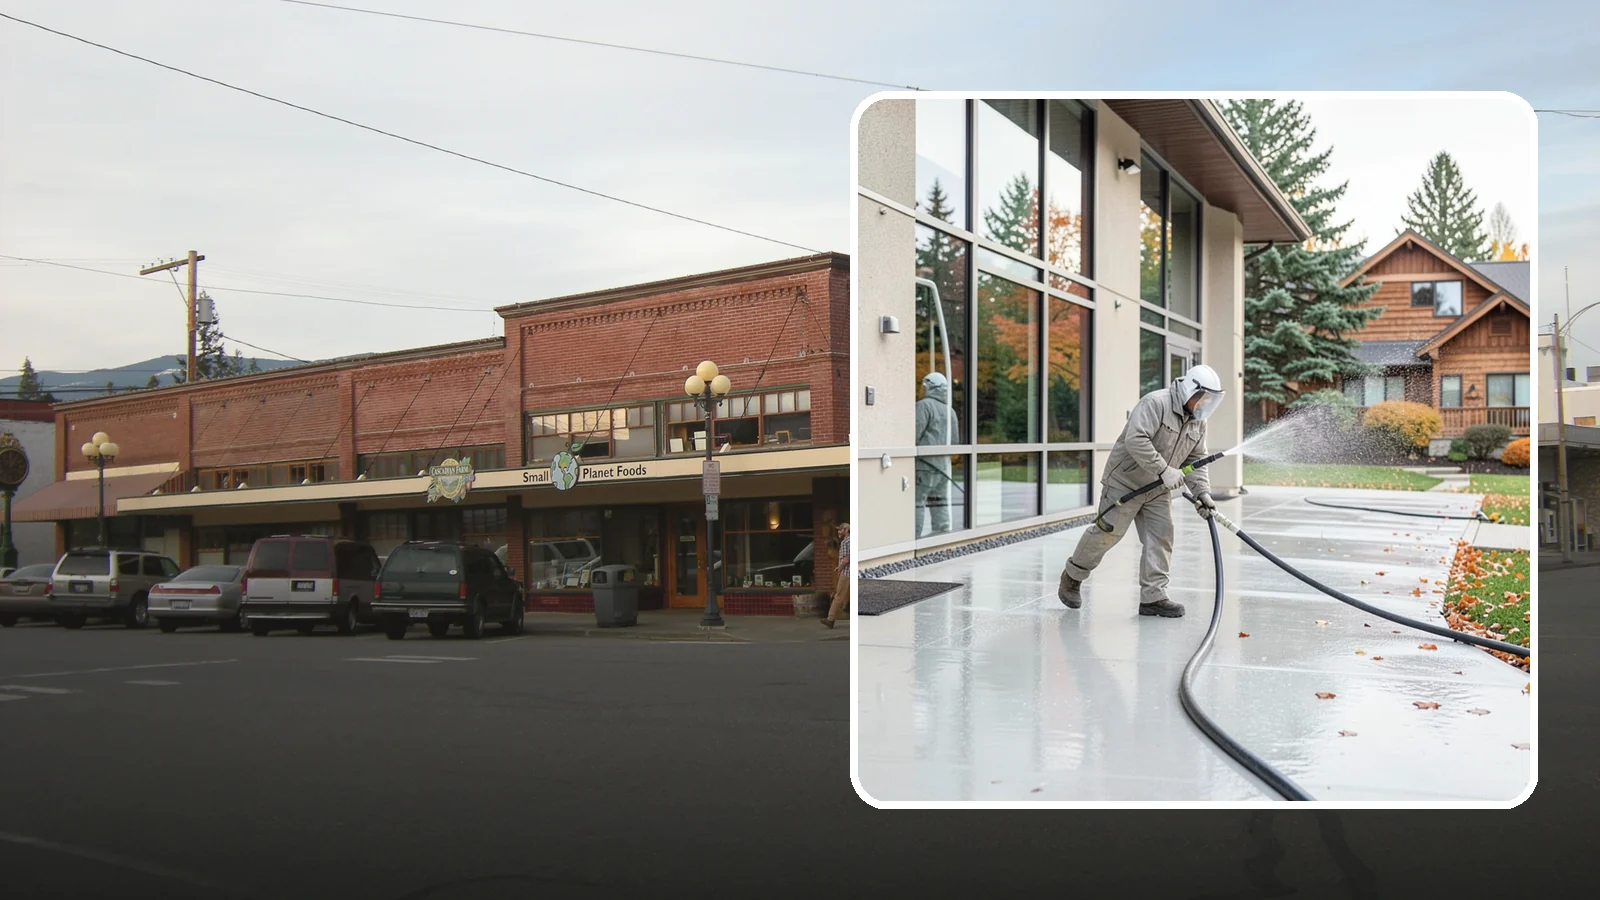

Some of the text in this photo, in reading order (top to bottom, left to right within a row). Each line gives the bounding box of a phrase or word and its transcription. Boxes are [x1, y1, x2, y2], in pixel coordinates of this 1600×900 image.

[523, 464, 647, 483] Small Planet Foods
